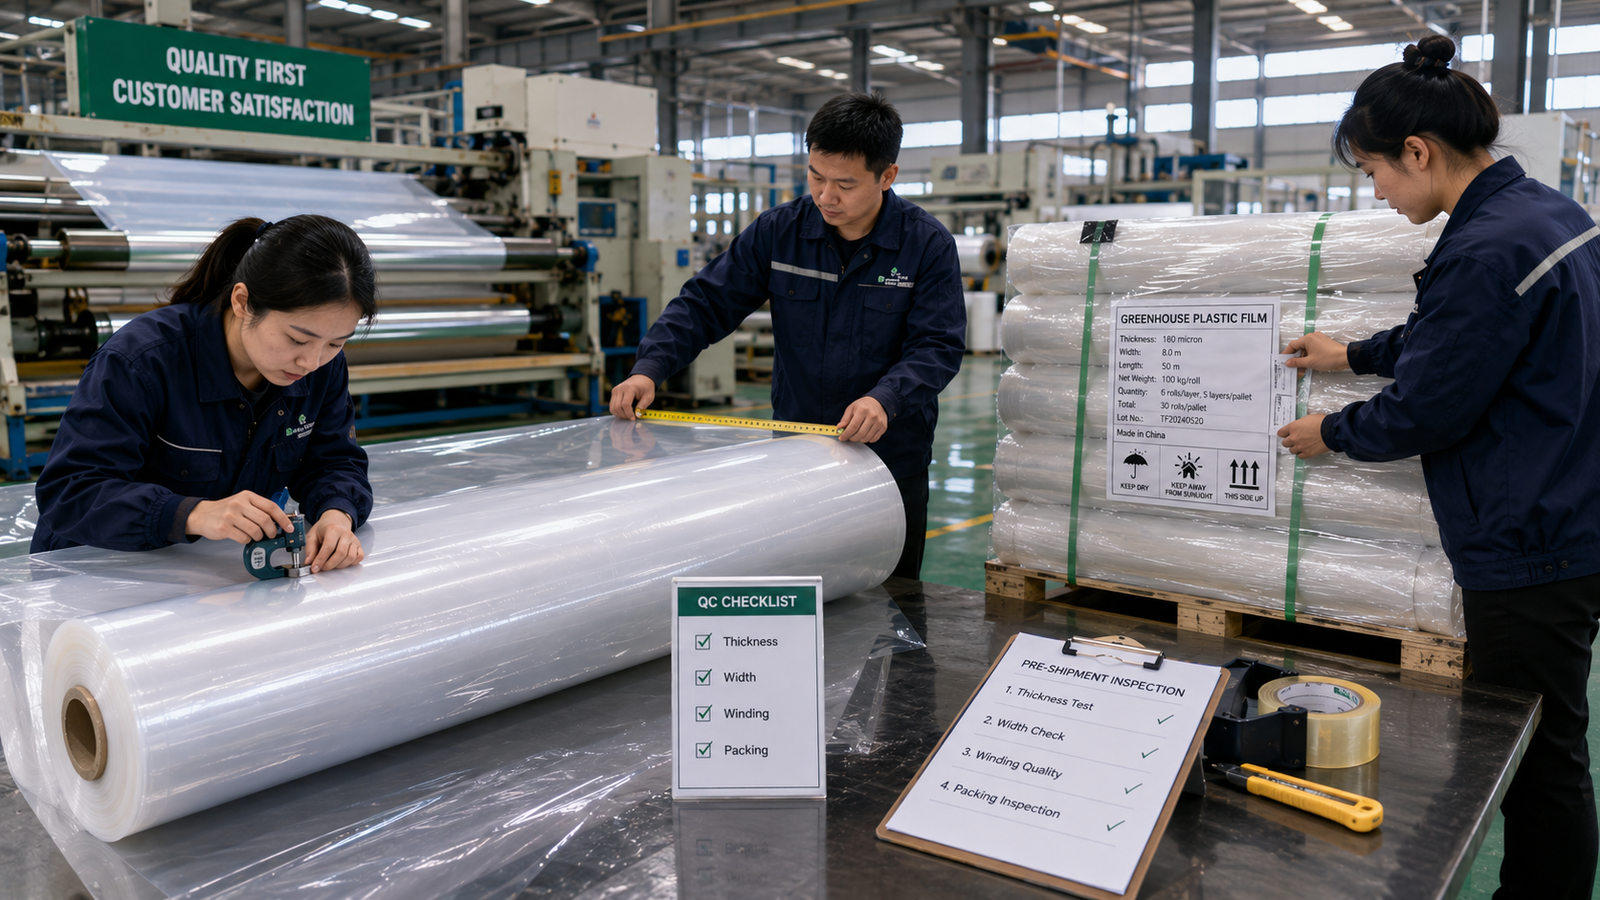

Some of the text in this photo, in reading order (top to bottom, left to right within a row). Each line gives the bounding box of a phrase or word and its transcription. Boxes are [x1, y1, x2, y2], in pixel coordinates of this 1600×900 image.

[166, 46, 306, 87] QUALITY FIRST
[112, 78, 354, 126] CUSTOMER SATISFACTION
[1120, 312, 1268, 324] GREENHOUSE PLASTIC FILM
[1120, 335, 1203, 344] Thickness: 180 micron
[1119, 348, 1142, 356] Width:
[1162, 349, 1173, 357] 8.0
[1118, 361, 1144, 371] Length:
[1162, 362, 1171, 371] 50
[1131, 375, 1157, 384] Weight:
[1162, 375, 1176, 384] 100
[1177, 376, 1201, 386] kg/roll
[1117, 387, 1148, 397] Quantity:
[1160, 388, 1166, 396] 6
[1209, 391, 1252, 402] layers/pallet
[1117, 400, 1207, 413] Total: 30 rolls/pallet
[1116, 414, 1128, 422] Lot
[1160, 414, 1204, 425] TF20240520
[1116, 428, 1166, 440] Made in China
[1120, 482, 1149, 491] KEEP DRY
[1171, 481, 1207, 491] KEEP AWAY
[1224, 492, 1239, 500] THIS
[697, 595, 798, 609] QC CHECKLIST
[723, 636, 778, 647] Thickness
[724, 672, 757, 683] Width
[1021, 659, 1186, 698] PRE-SHIPMENT INSPECTION
[1005, 685, 1095, 712] 1. Thickness Test
[724, 708, 770, 721] Winding
[983, 715, 1066, 742] 2. Width Check
[724, 745, 769, 758] Packing
[961, 747, 1063, 781] 3. Winding Quality
[940, 781, 1061, 819] 4. Packing Inspection
